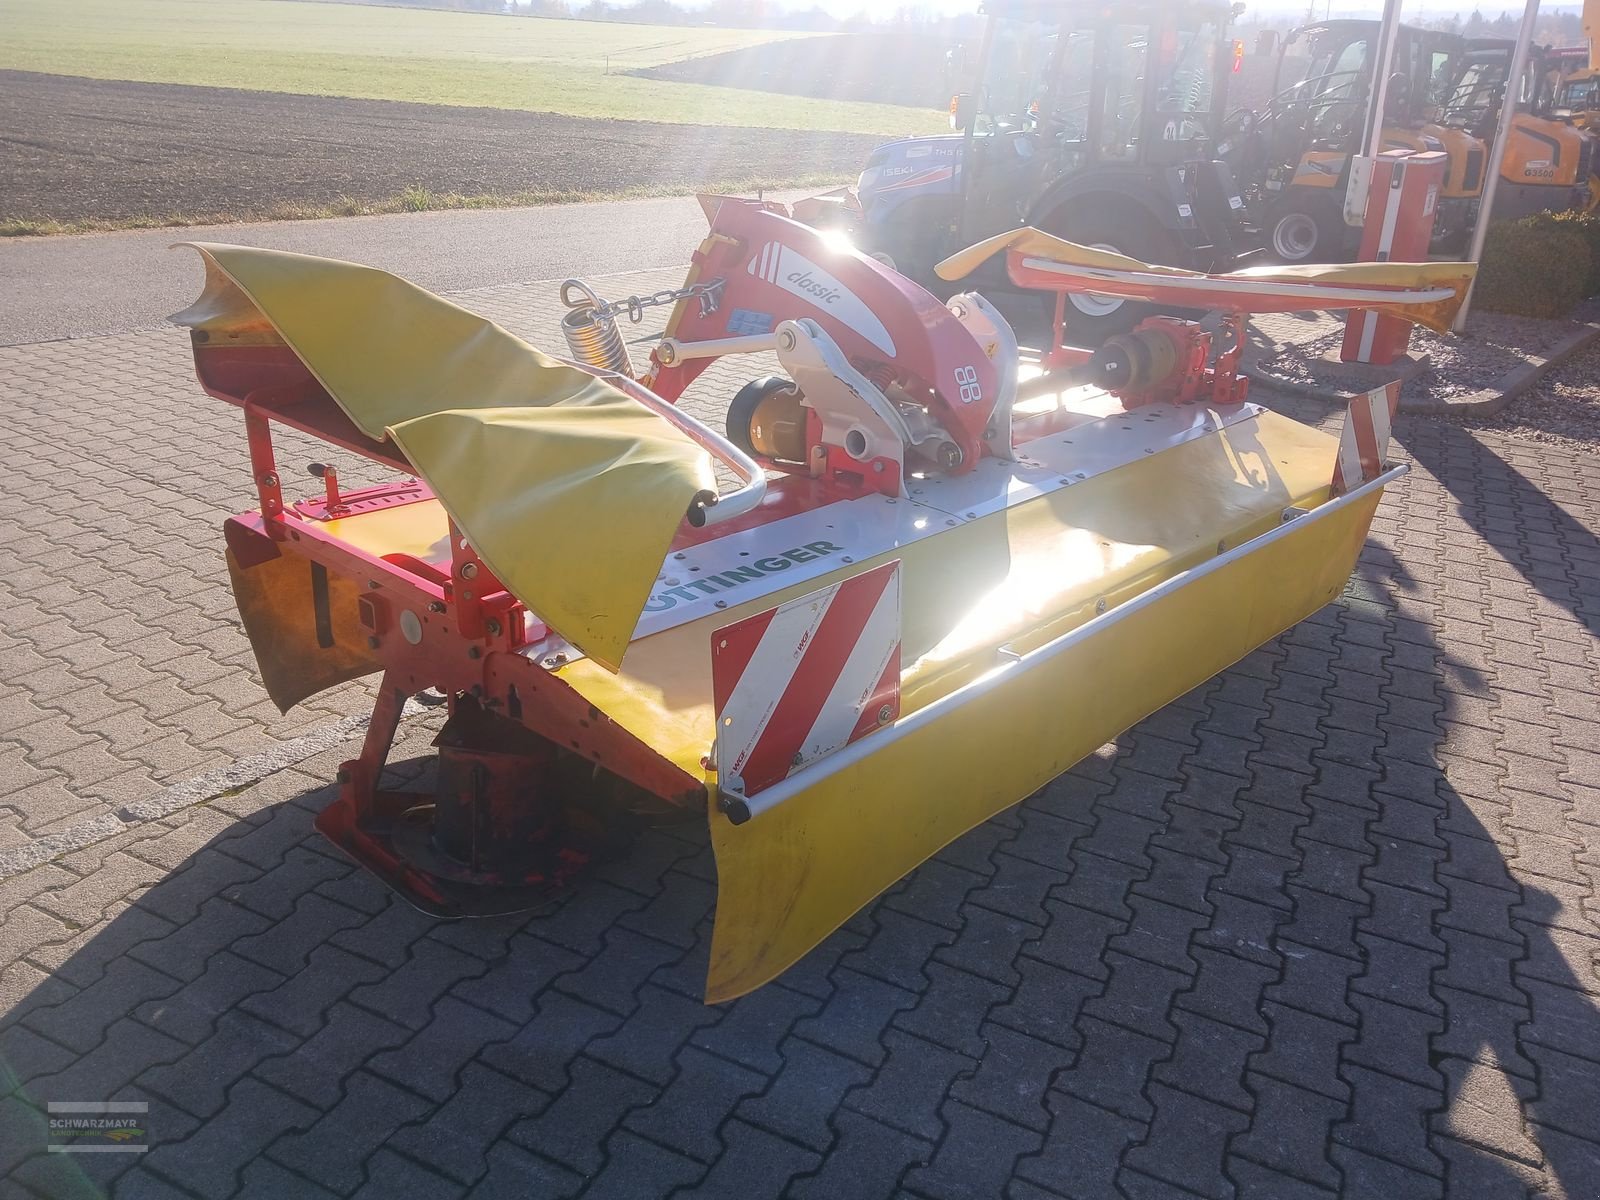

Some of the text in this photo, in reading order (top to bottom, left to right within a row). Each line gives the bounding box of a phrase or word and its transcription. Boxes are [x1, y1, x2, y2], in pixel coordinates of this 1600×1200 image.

[883, 166, 913, 177] ISEKI
[1524, 169, 1554, 178] G3500
[787, 271, 841, 304] classic
[797, 630, 809, 651] WGF
[732, 749, 746, 772] WGF
